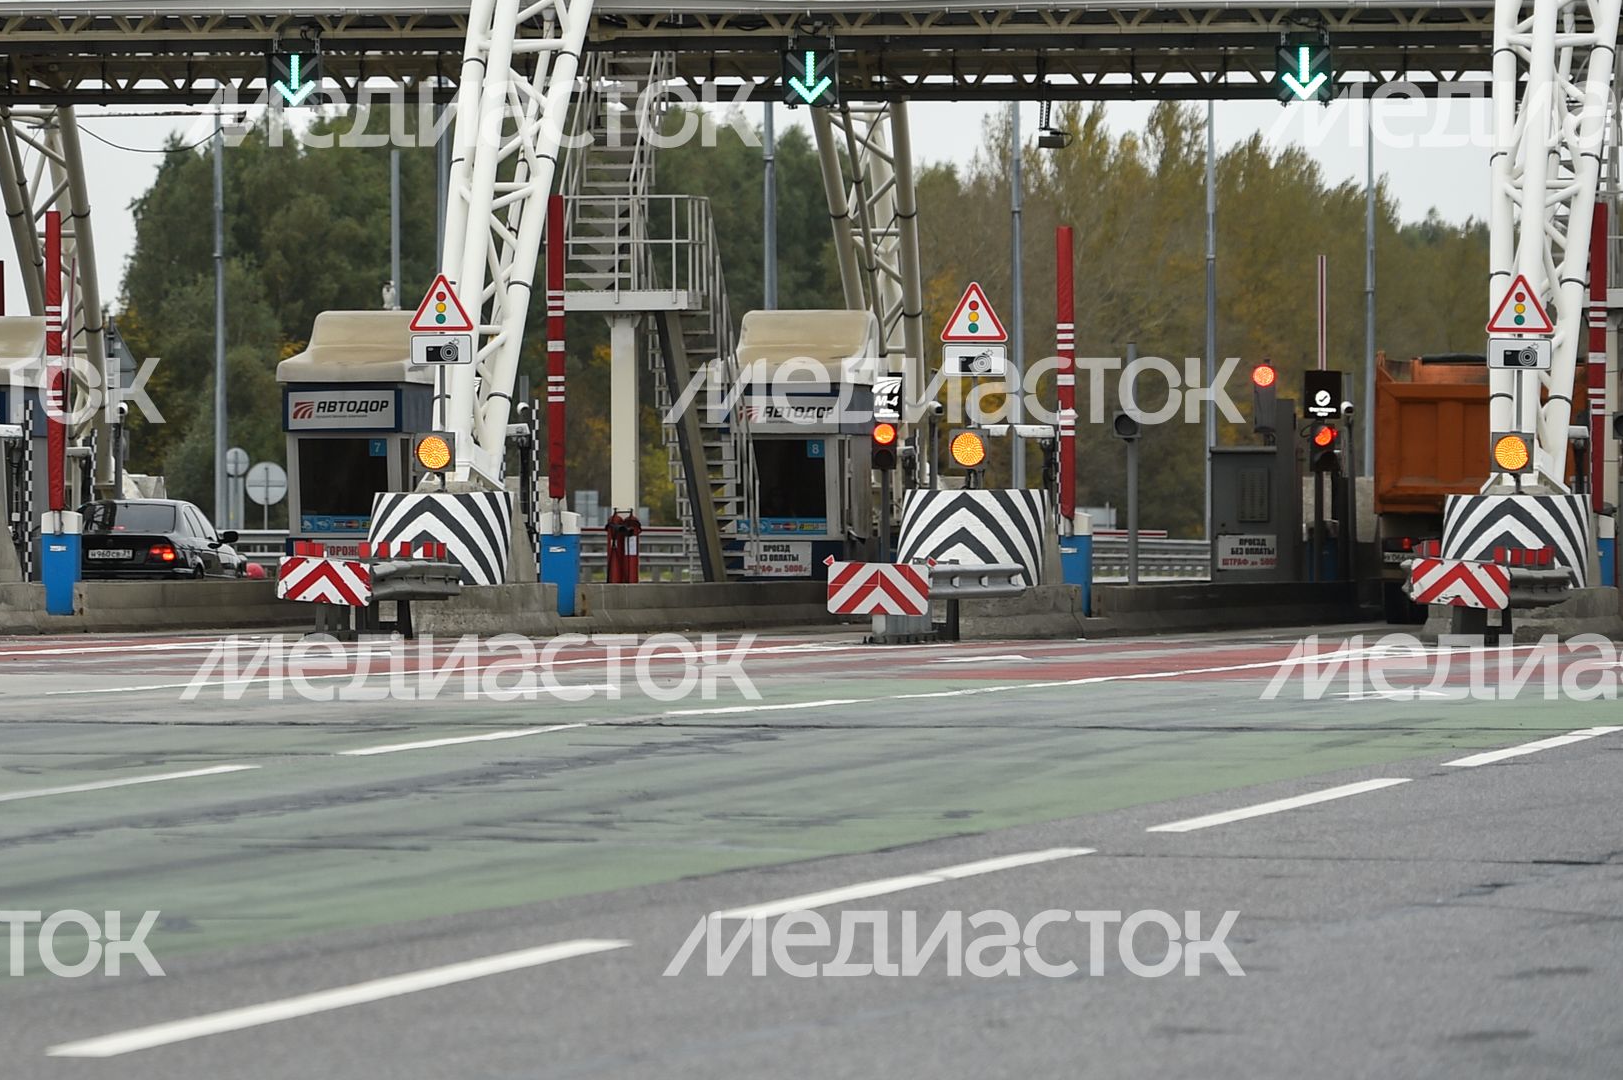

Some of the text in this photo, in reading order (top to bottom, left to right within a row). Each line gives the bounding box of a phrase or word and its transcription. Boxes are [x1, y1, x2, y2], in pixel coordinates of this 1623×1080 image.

[316, 400, 389, 414] АВТОДОР
[762, 406, 834, 419] АВТОДОР
[374, 442, 381, 453] 7
[811, 443, 819, 454] 8
[1239, 538, 1267, 546] ПРОЕЗД
[763, 544, 791, 553] ПРОЕЗД
[756, 554, 768, 562] ЕЗ
